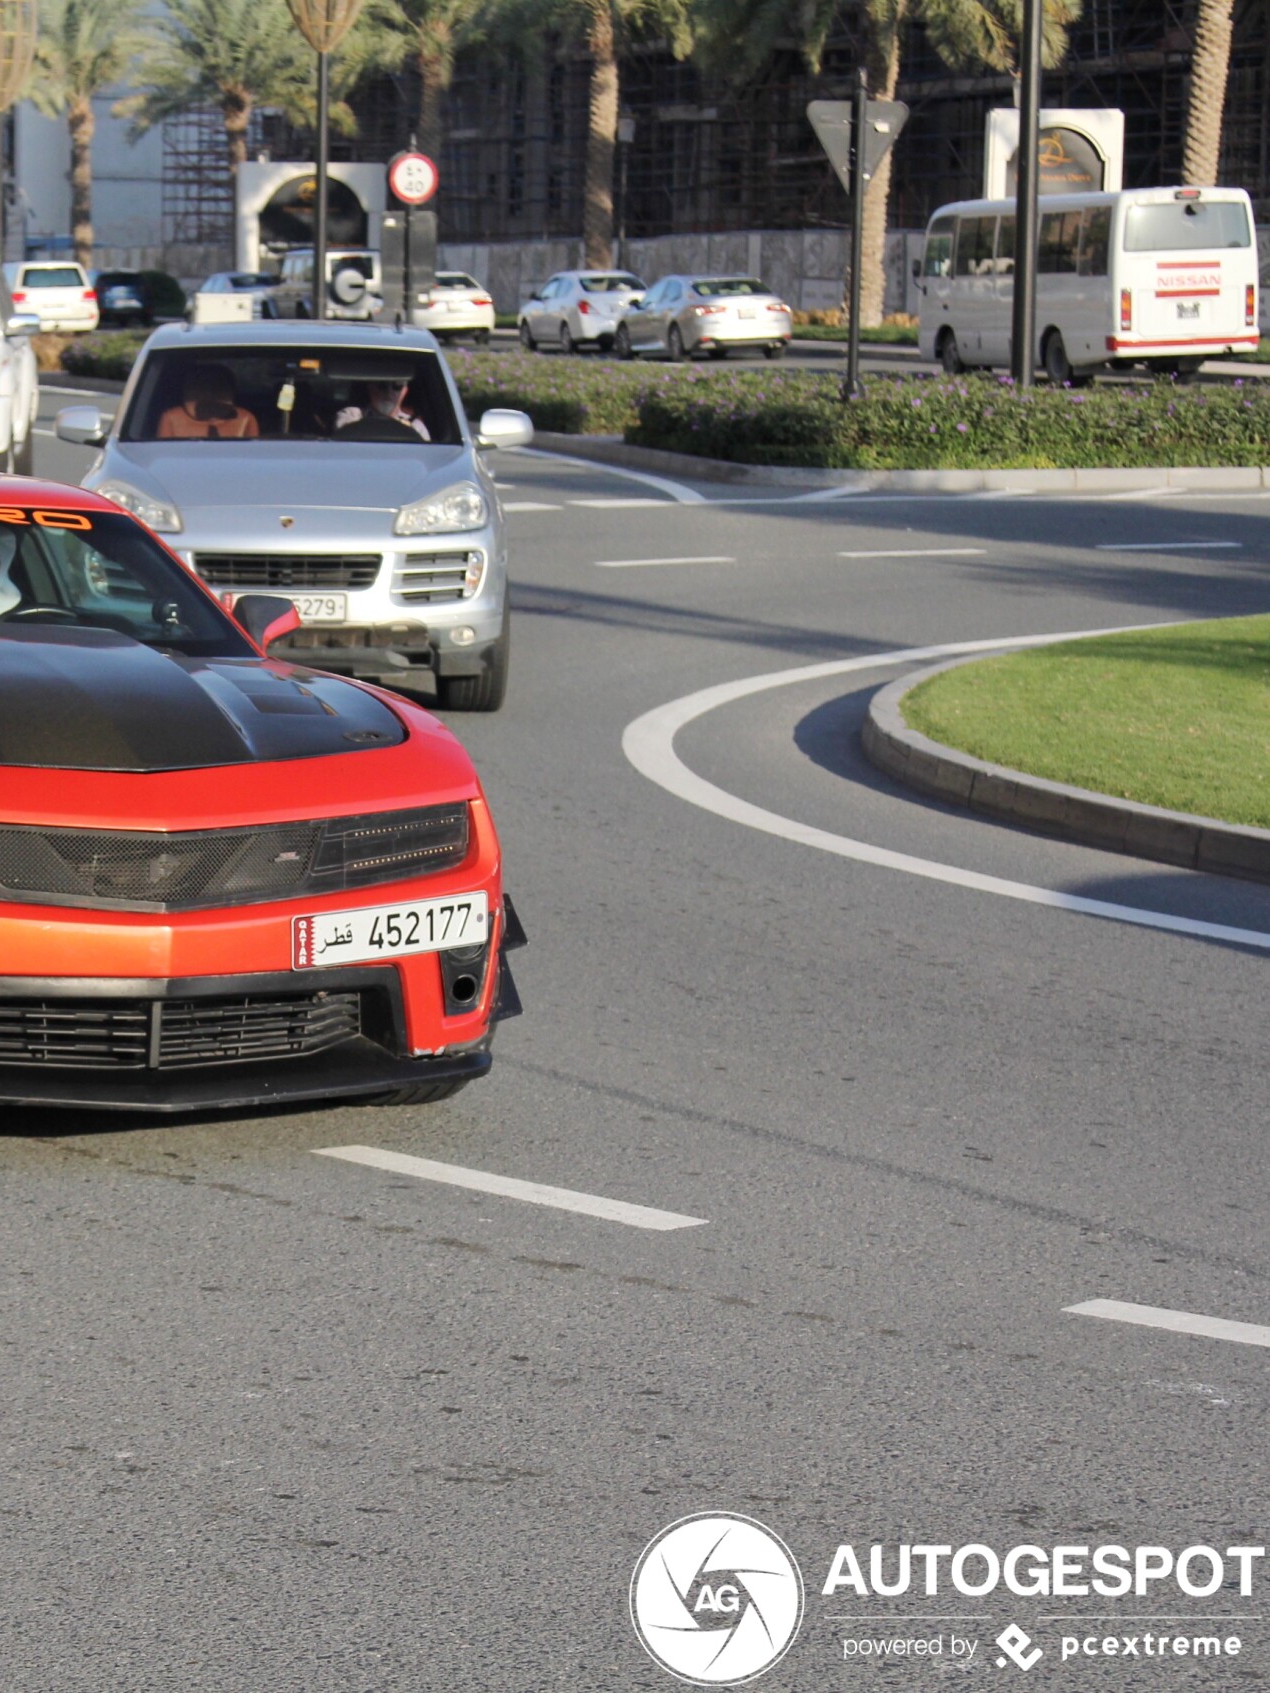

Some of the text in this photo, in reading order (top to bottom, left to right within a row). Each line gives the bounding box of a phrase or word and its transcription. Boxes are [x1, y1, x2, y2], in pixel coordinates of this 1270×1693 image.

[404, 180, 425, 193] 40
[1157, 275, 1221, 287] NISSAN
[316, 924, 353, 954] قطر
[368, 903, 472, 949] 452177
[298, 920, 308, 965] QATAR
